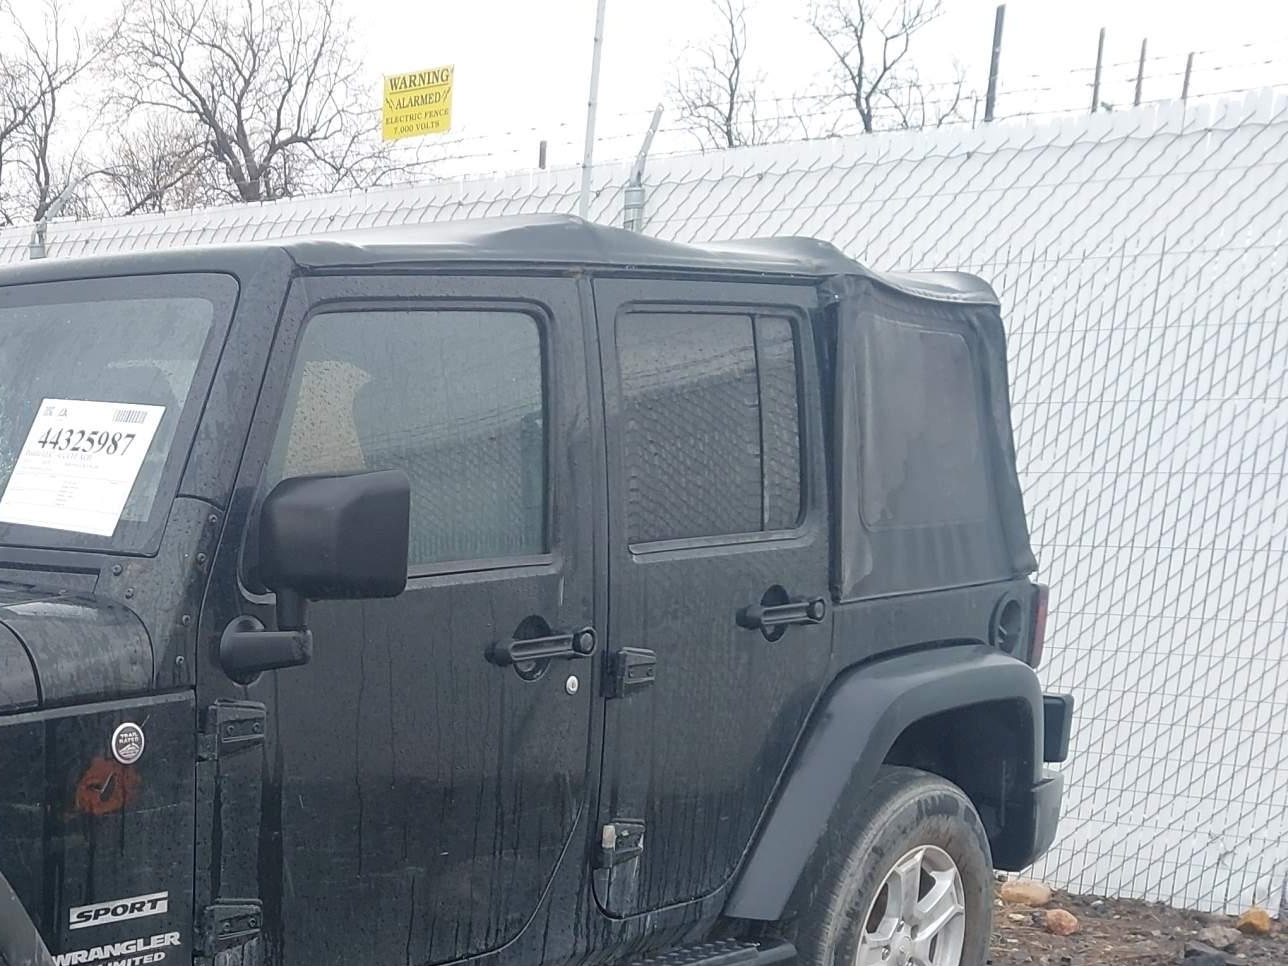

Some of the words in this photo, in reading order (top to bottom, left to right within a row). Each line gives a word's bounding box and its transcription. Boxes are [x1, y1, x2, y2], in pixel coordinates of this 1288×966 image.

[390, 68, 449, 91] WARNING
[395, 92, 441, 110] ALARMED
[386, 112, 422, 125] ELECTRIC
[425, 109, 449, 119] FENCE
[416, 121, 439, 131] VOLTS
[37, 427, 136, 456] 44325987
[75, 898, 161, 925] SPORT
